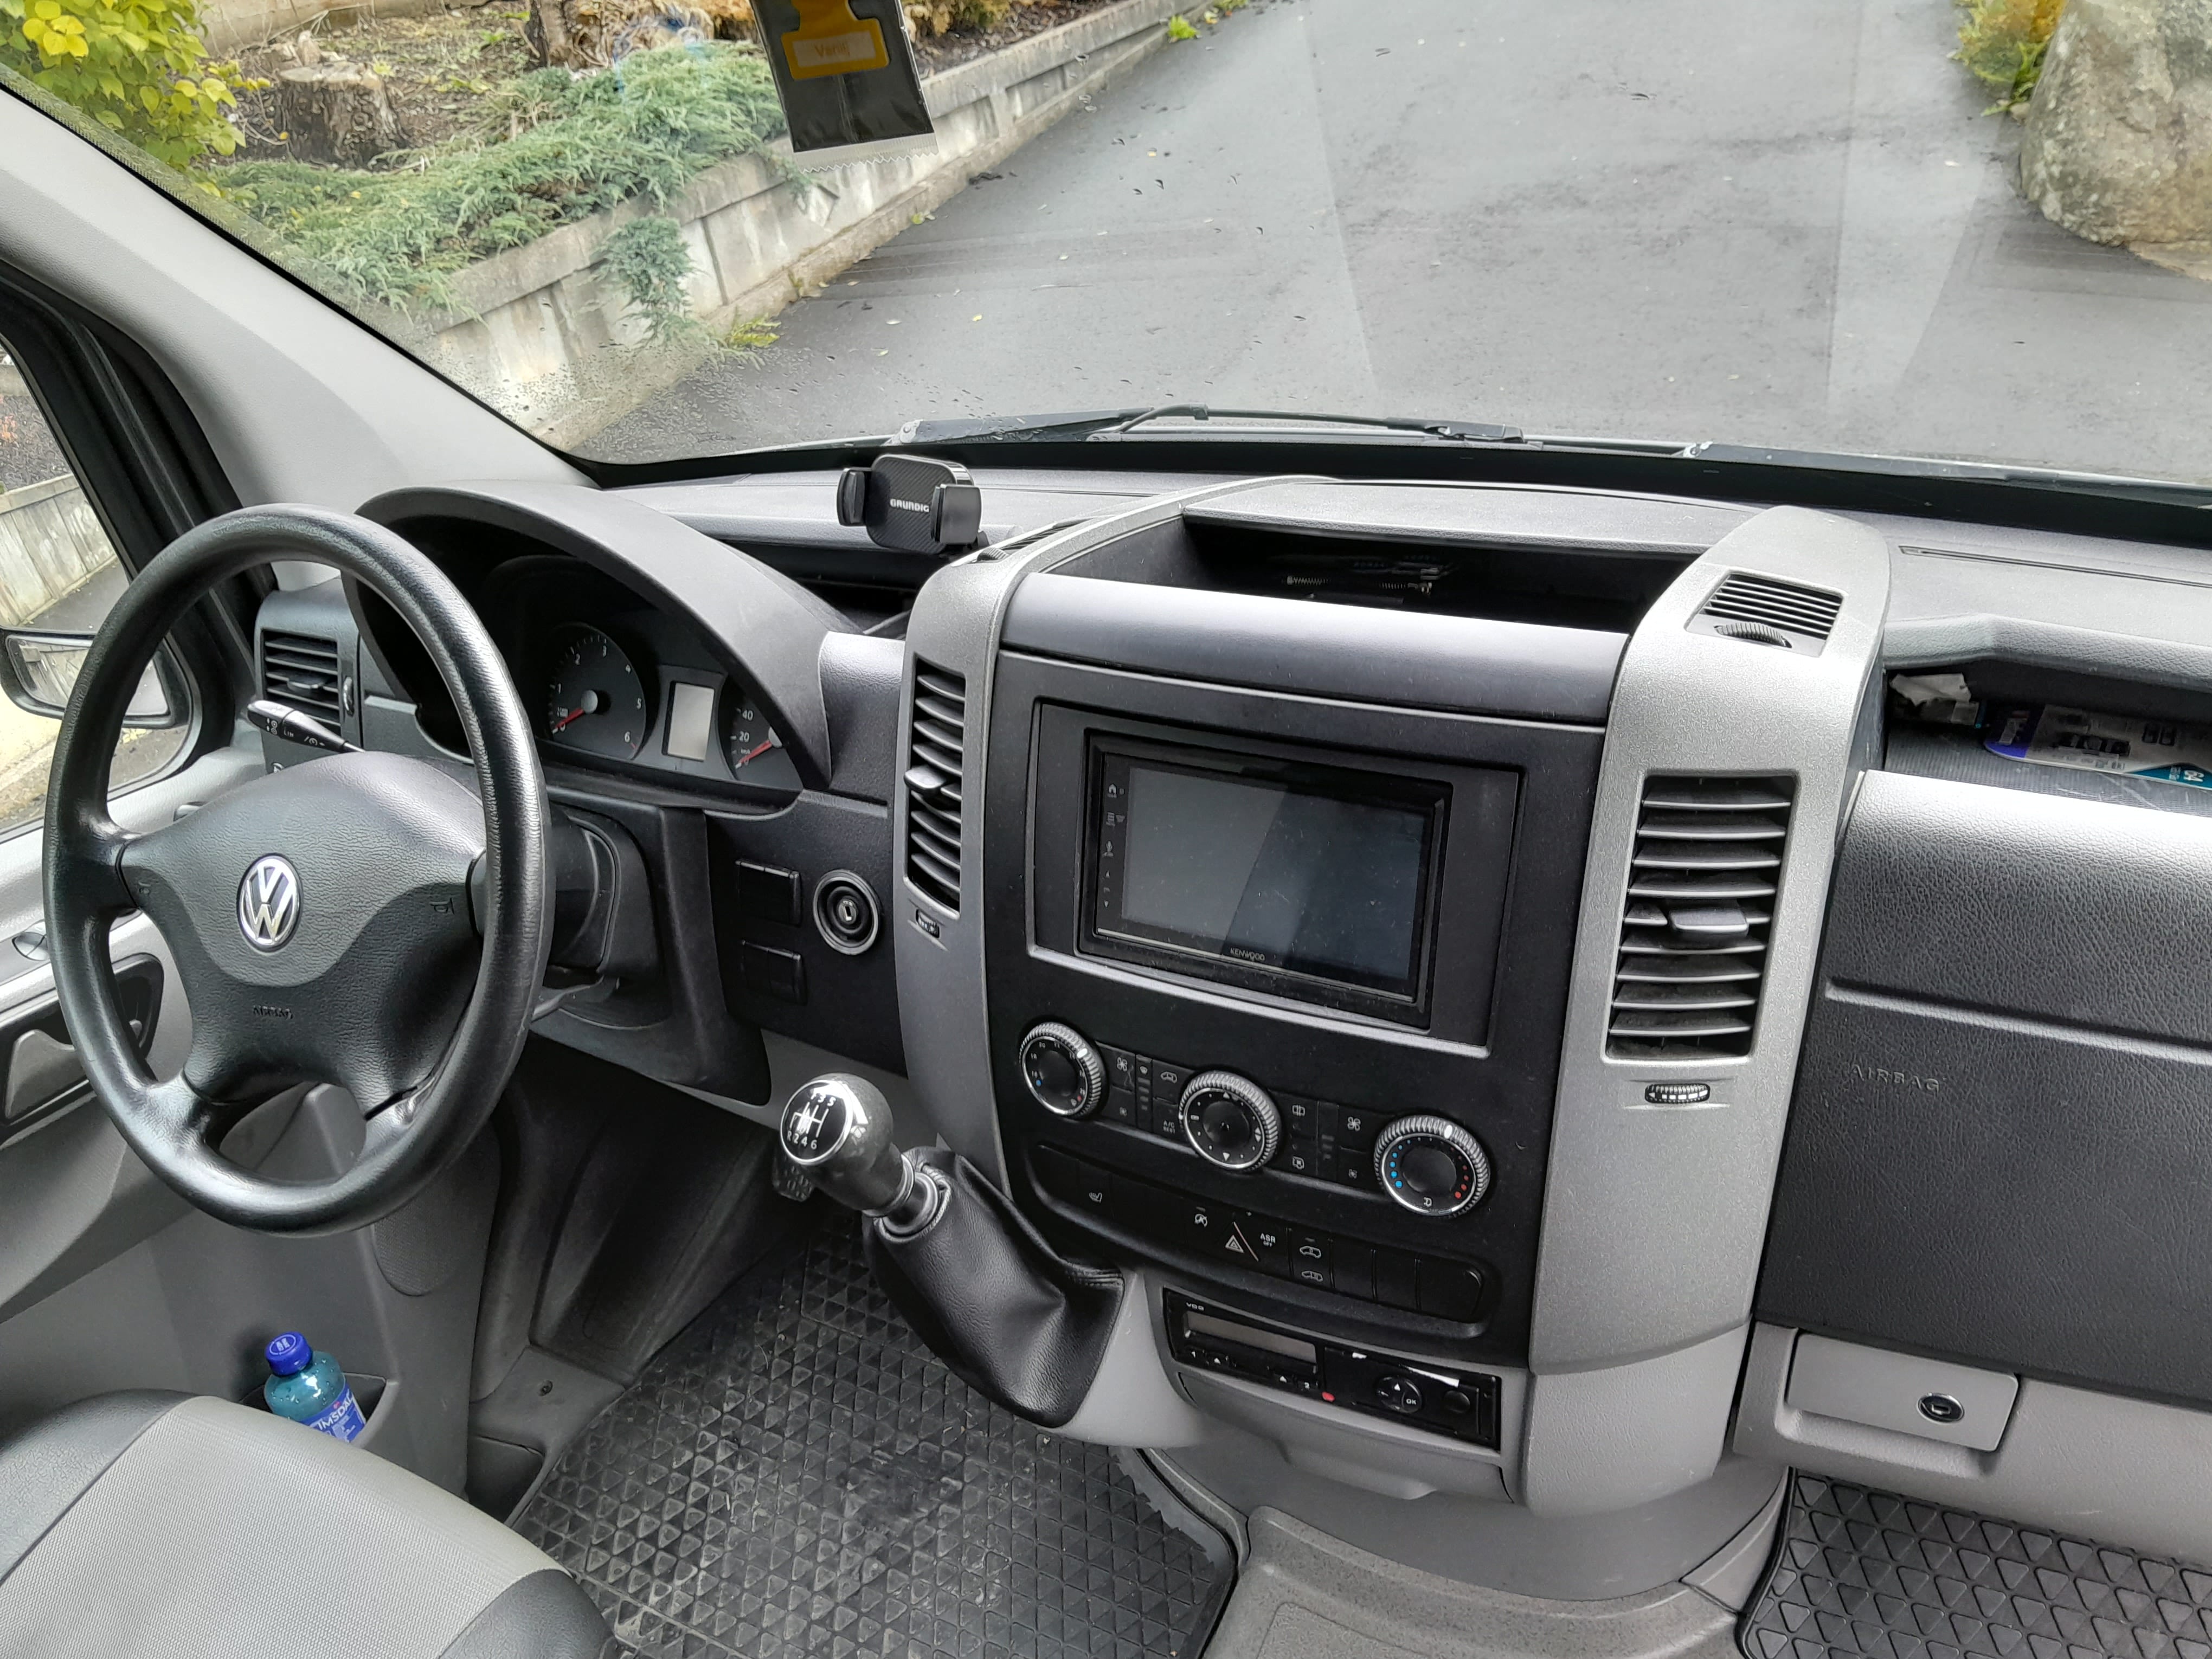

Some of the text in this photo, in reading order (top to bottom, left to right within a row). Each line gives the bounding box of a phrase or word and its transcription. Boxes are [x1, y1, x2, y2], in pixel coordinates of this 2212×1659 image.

[890, 498, 929, 512] GRUNDIG
[602, 645, 607, 658] 3
[575, 654, 581, 665] 2
[557, 683, 562, 694] 1
[636, 698, 642, 710] 5
[742, 710, 754, 721] 40
[624, 731, 631, 743] 6
[739, 731, 750, 743] 20
[1230, 948, 1265, 961] KENWOOD
[1851, 1064, 1939, 1093] AIRBAG
[827, 1096, 836, 1106] 5
[1163, 1120, 1175, 1128] A/C
[787, 1130, 818, 1150] R 2 4 6
[1260, 1233, 1276, 1244] ASR
[1304, 1381, 1310, 1390] 2
[317, 1388, 353, 1431] IMSDAL
